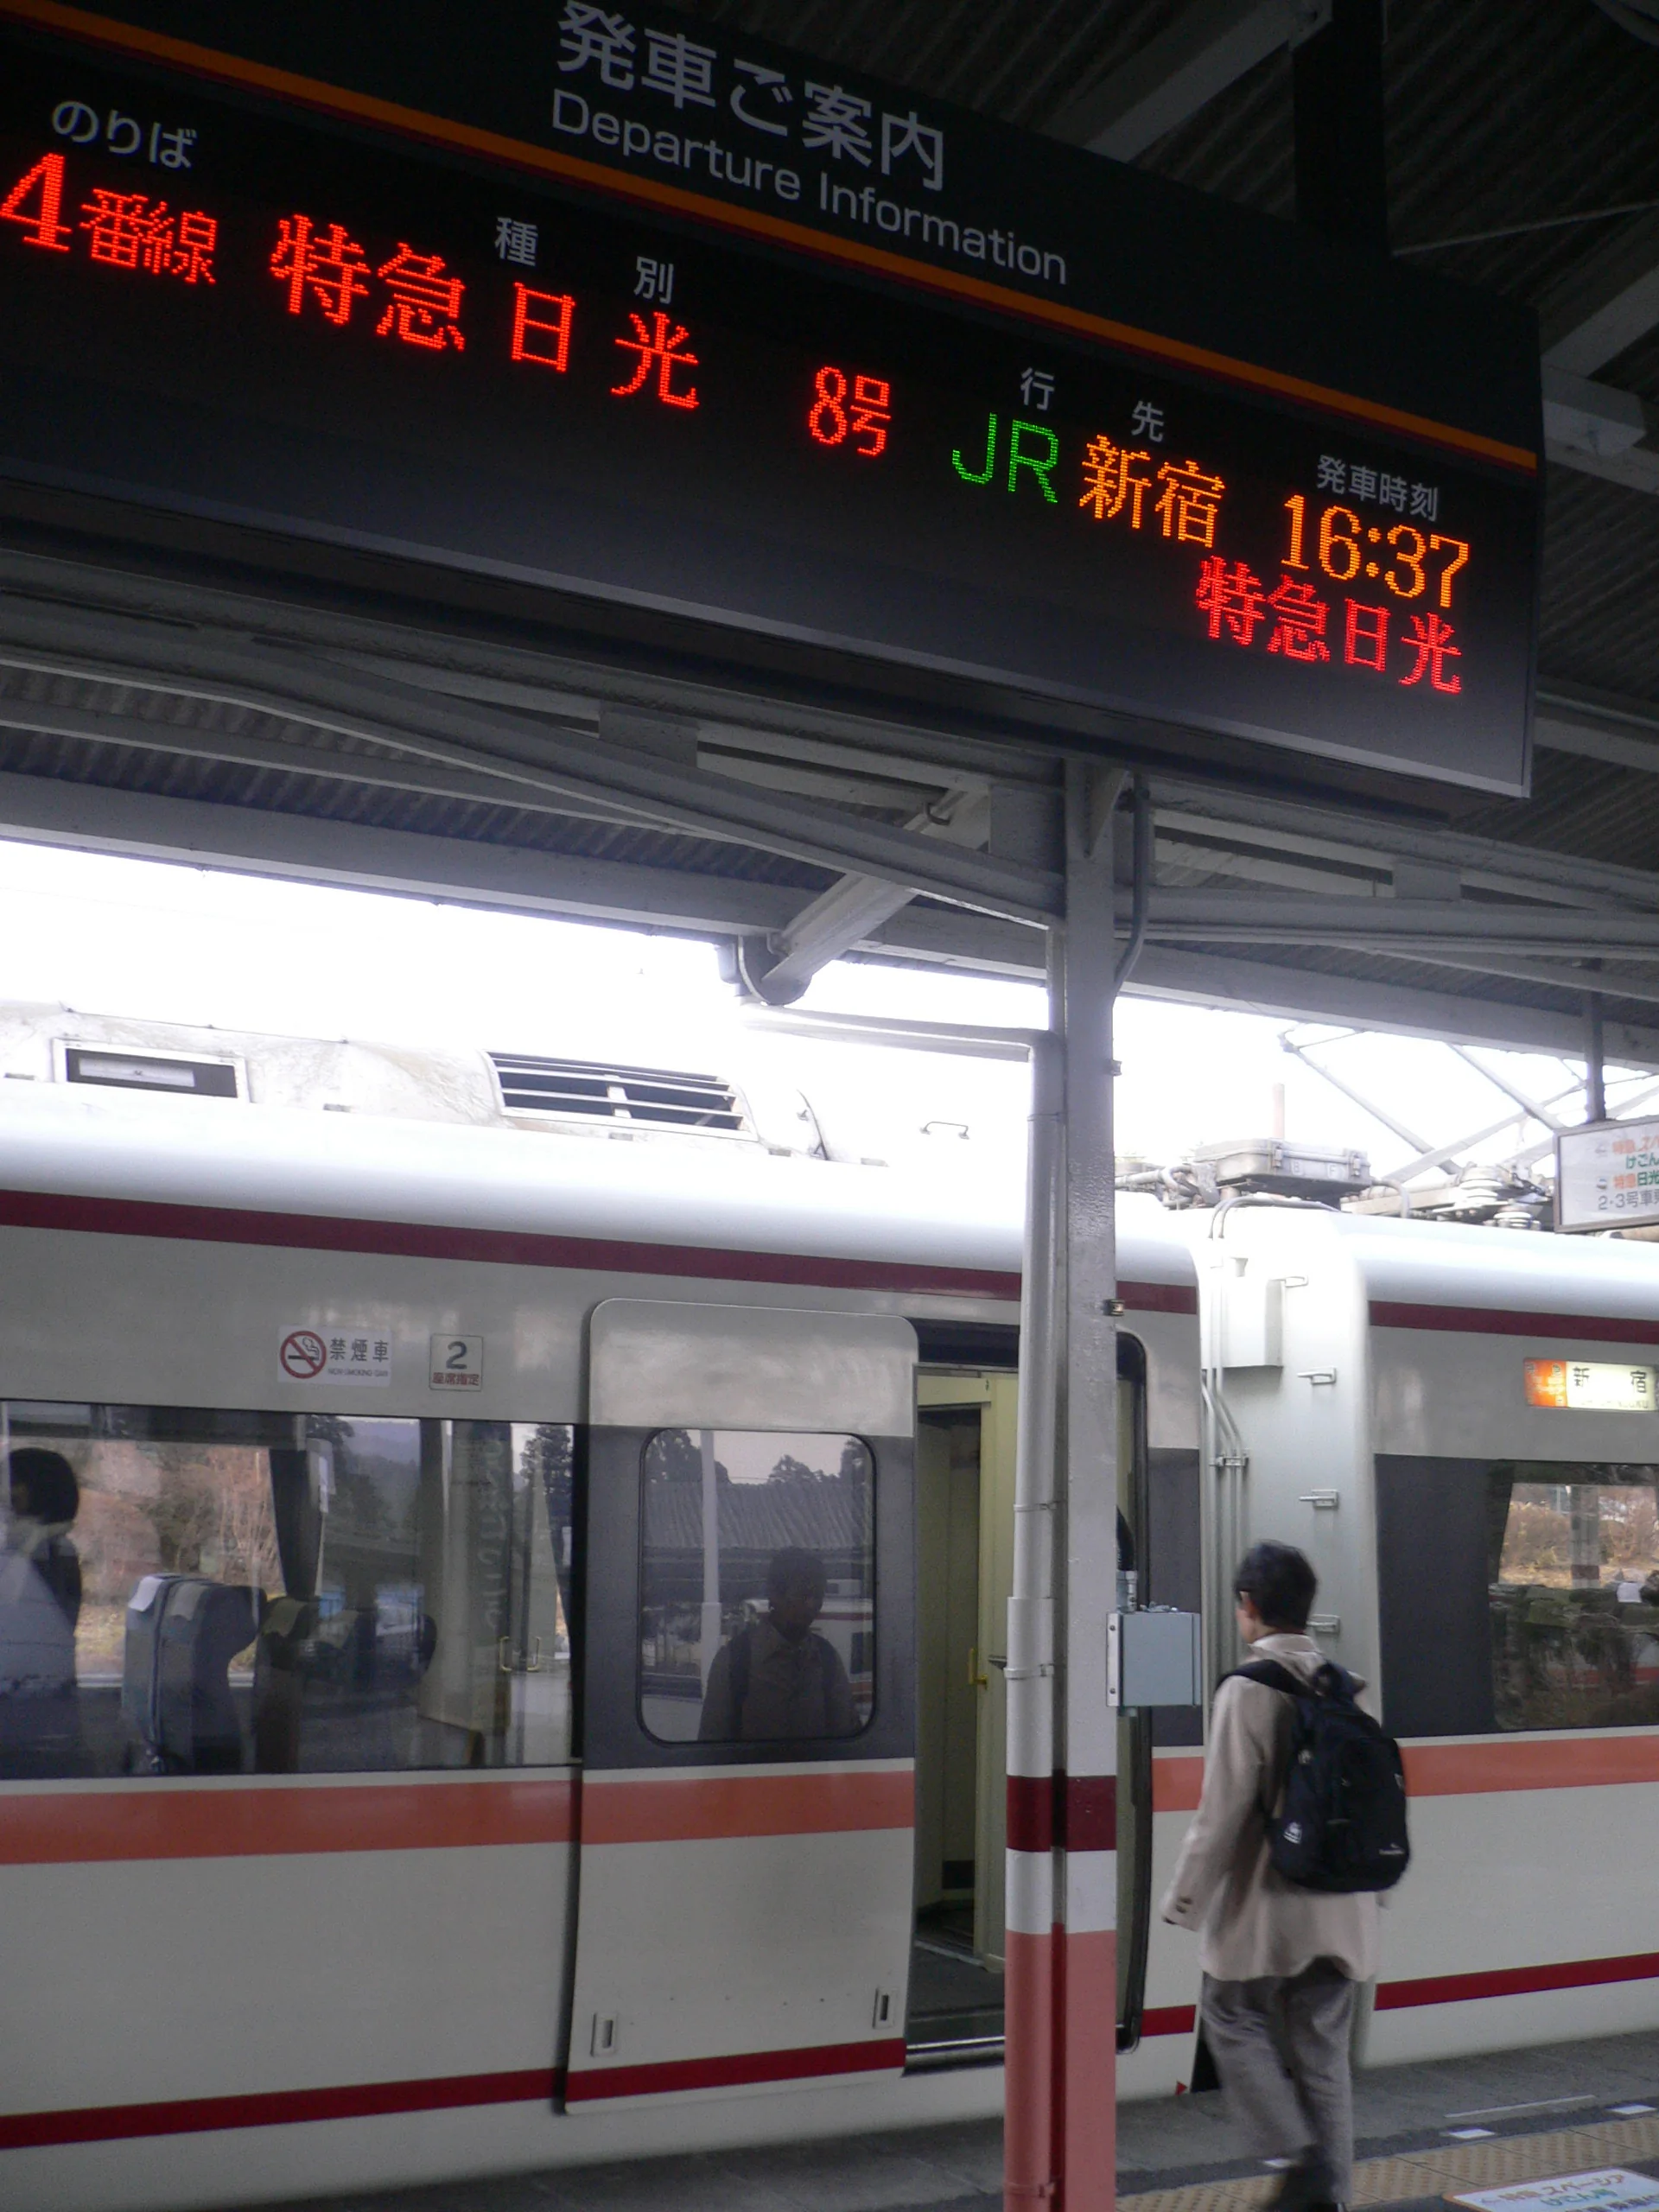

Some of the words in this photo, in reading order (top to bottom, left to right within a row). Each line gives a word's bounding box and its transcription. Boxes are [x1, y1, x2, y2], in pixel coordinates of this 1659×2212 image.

[556, 0, 944, 191] 発車ご案内
[52, 100, 197, 169] のりば
[552, 88, 800, 200] Departure
[820, 171, 1067, 285] Information
[0, 153, 217, 284] 4番線
[808, 365, 892, 457] 8号
[1281, 494, 1468, 607] 16:37
[1316, 454, 1439, 522] 発車時刻
[329, 1337, 389, 1363] 禁煙車
[446, 1341, 467, 1370] 2
